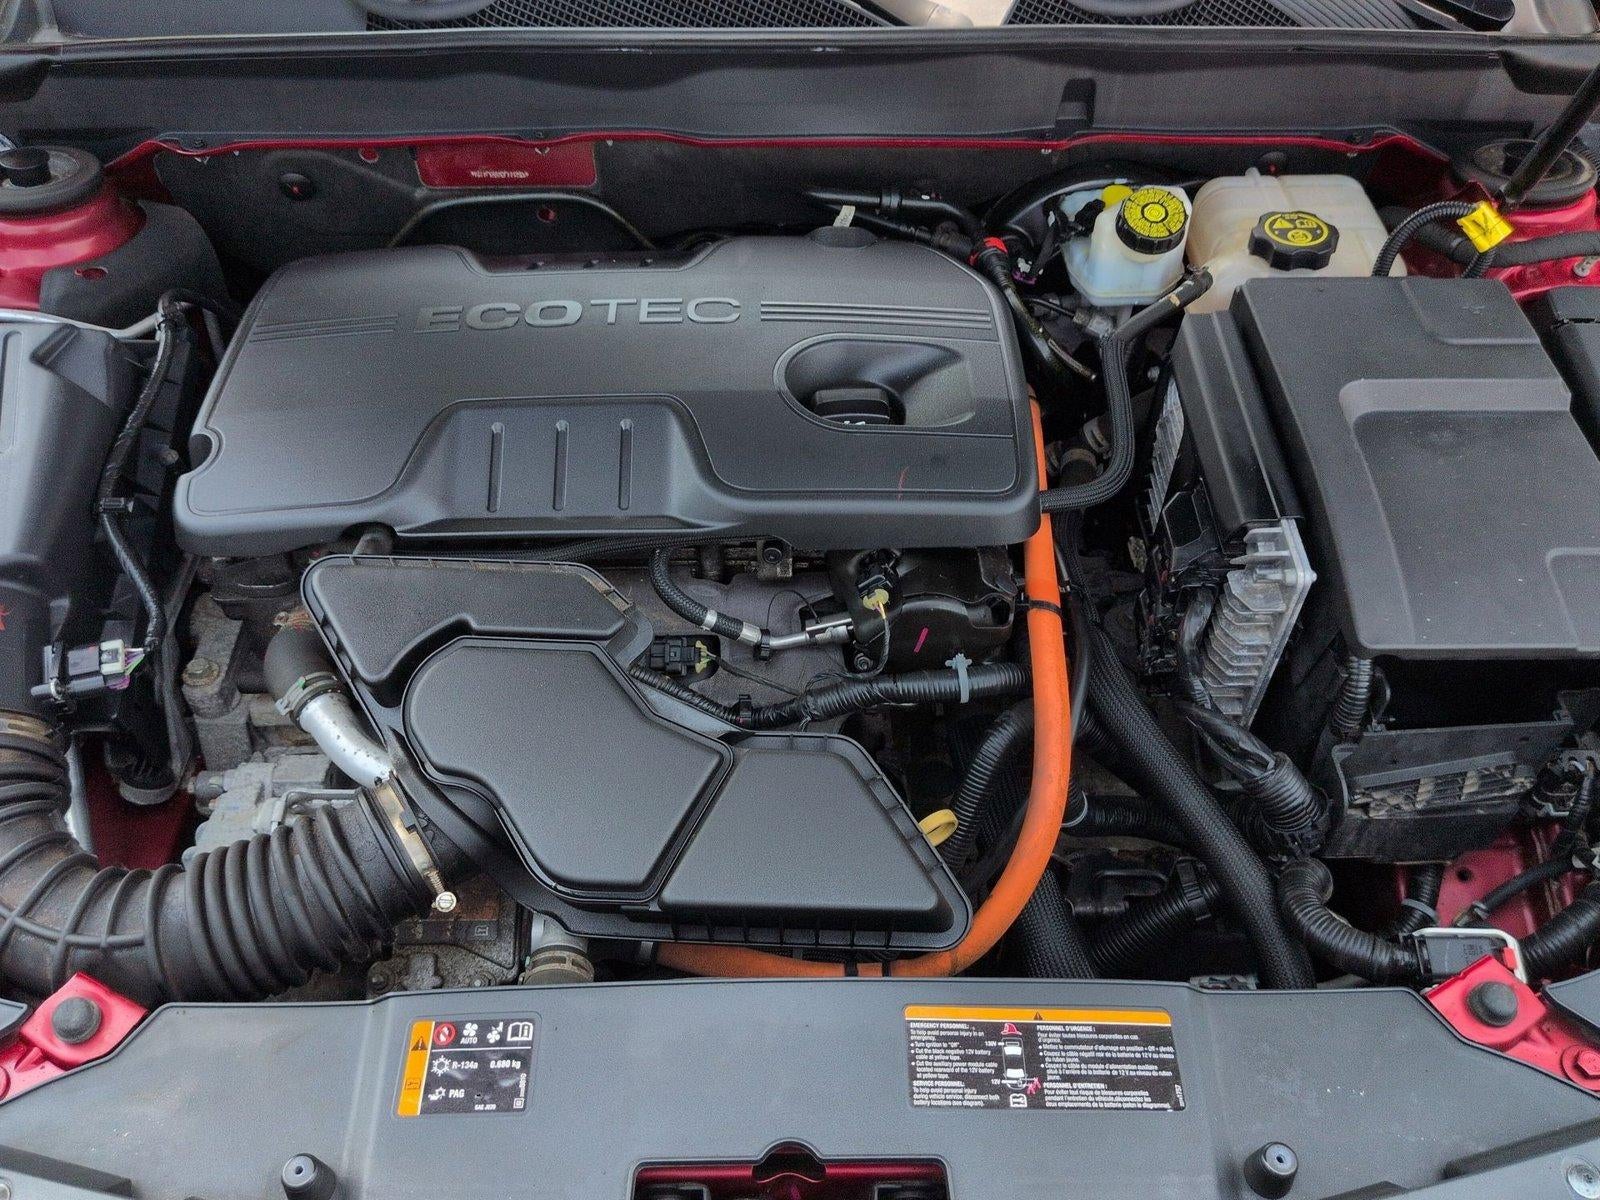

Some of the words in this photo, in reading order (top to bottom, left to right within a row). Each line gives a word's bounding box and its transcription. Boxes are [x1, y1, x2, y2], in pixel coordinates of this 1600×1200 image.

[414, 297, 740, 333] ECOTEC
[452, 1061, 478, 1069] R-134a
[512, 1060, 521, 1069] kg
[449, 1089, 465, 1098] PAG
